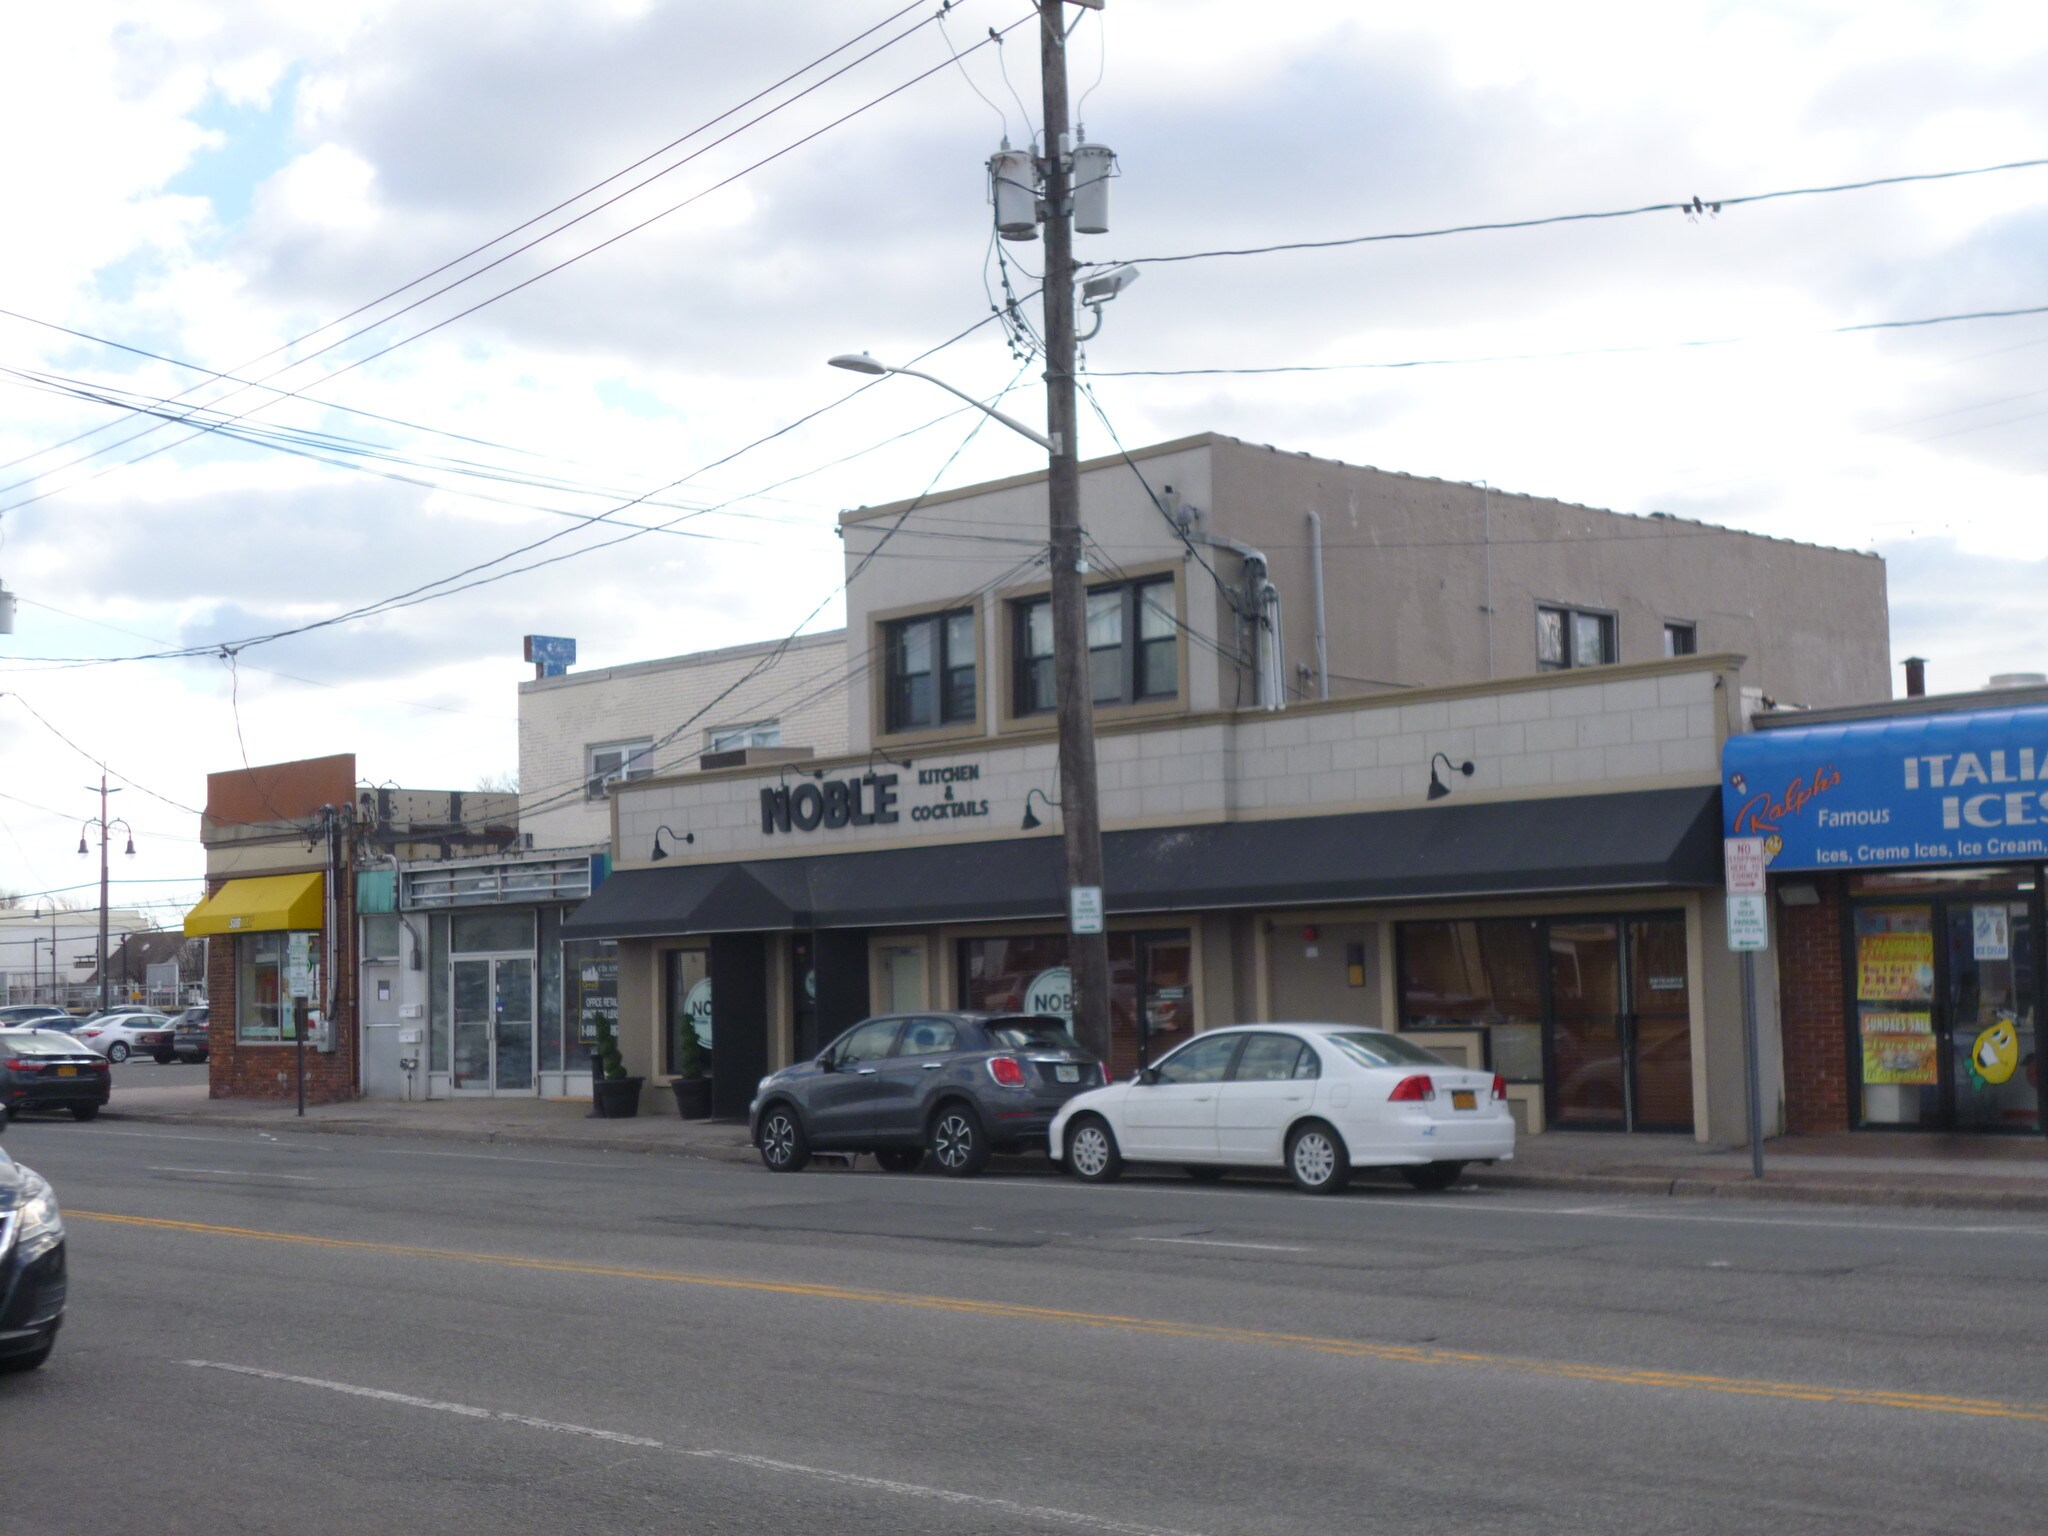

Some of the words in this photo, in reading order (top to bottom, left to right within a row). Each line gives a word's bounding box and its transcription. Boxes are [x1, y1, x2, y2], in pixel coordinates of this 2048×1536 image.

[918, 764, 980, 785] KITCHEN
[1904, 749, 2048, 790] ITALI
[760, 774, 900, 834] NOBLE
[944, 786, 955, 801] &
[911, 800, 989, 822] COCKTAILS
[1818, 808, 1890, 828] Famous
[1737, 844, 1751, 854] NO
[1817, 848, 1853, 864] Ices,
[1857, 845, 1910, 861] Creme
[1915, 842, 1953, 859] Ices,
[1958, 840, 1982, 855] Ice
